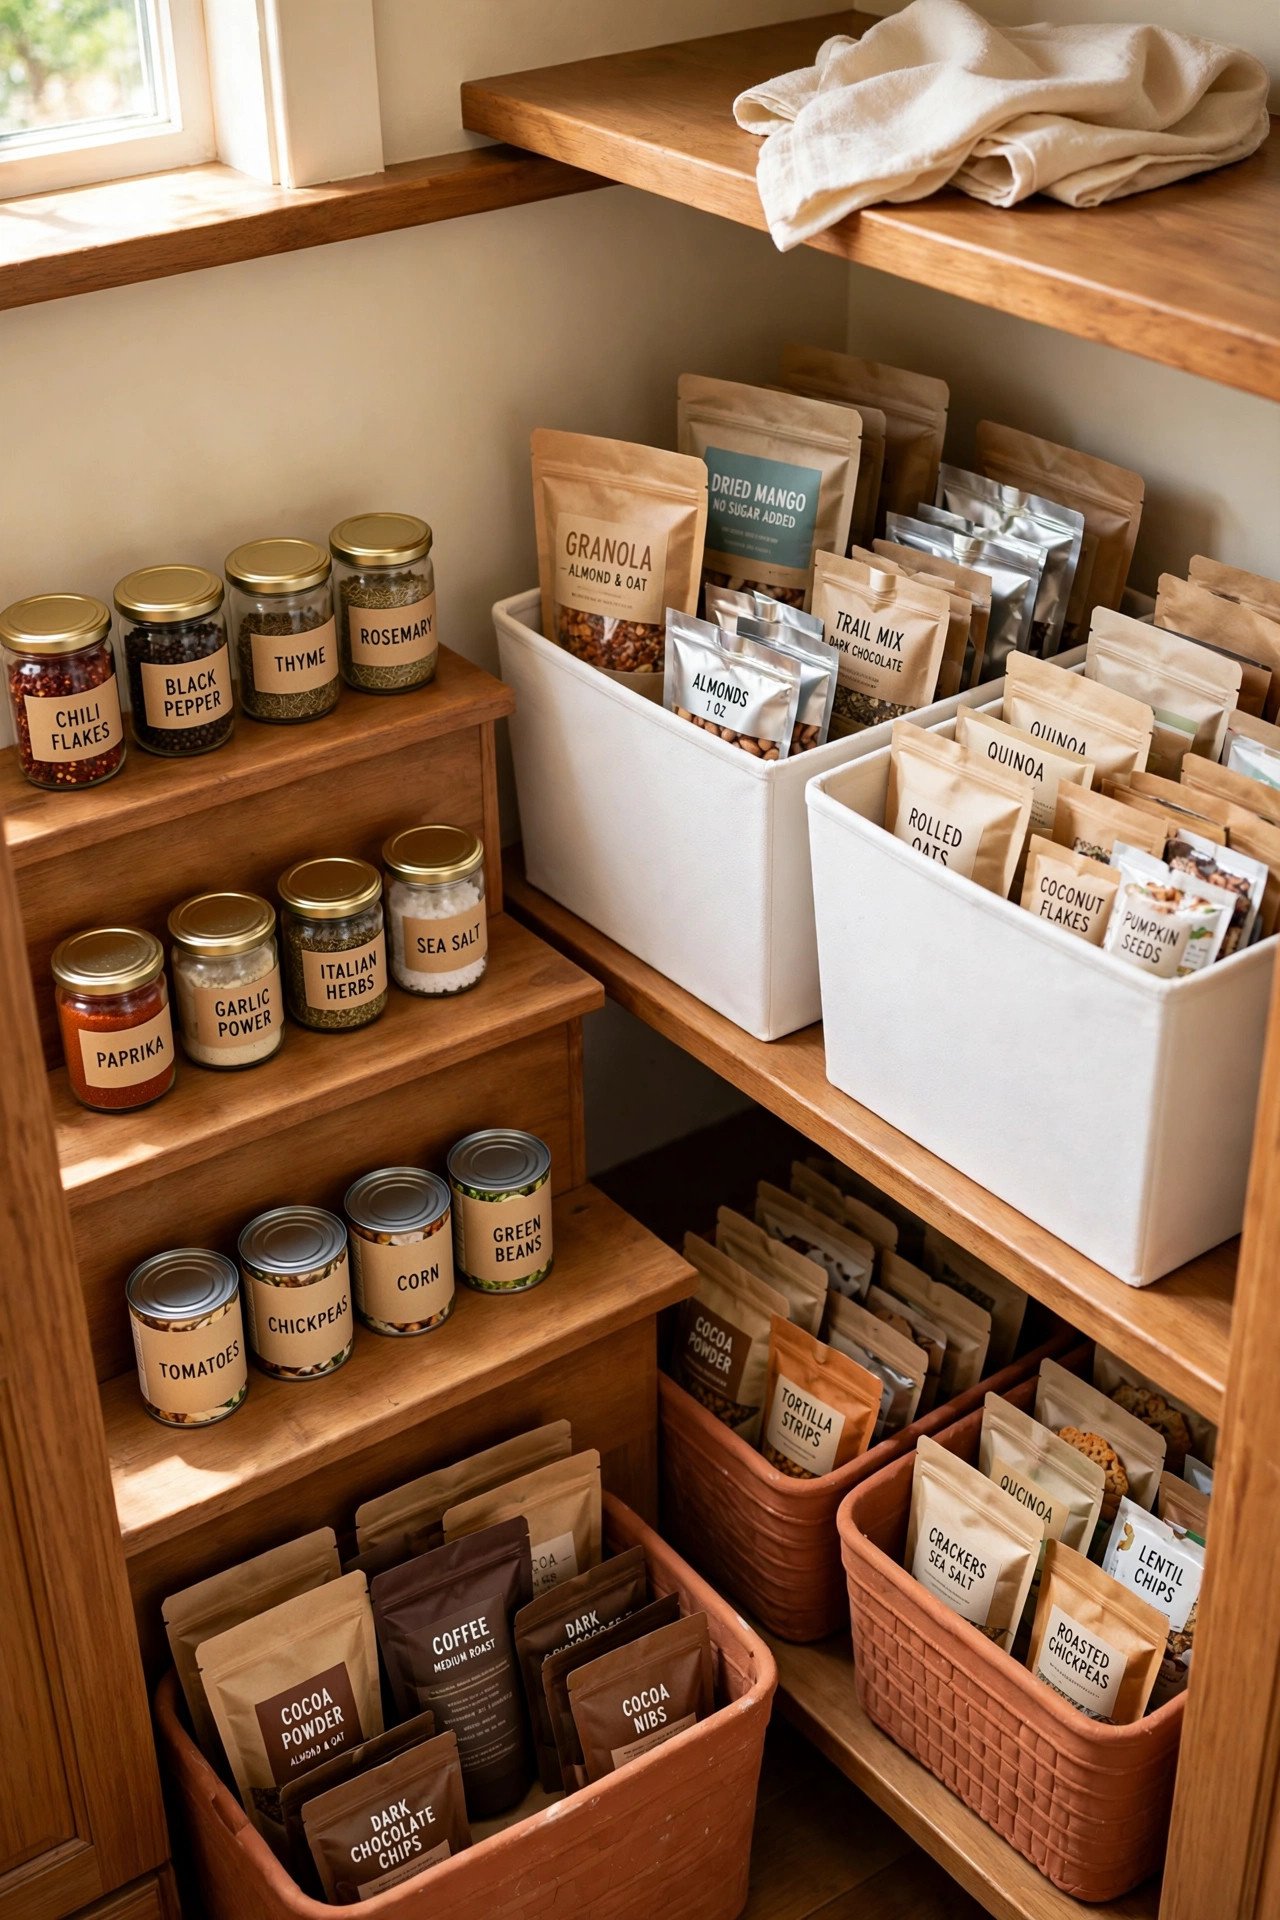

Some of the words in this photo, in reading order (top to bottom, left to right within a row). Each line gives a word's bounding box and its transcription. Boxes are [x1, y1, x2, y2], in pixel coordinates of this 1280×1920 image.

[712, 473, 752, 498] DRIED
[754, 484, 806, 512] MANGO
[713, 498, 726, 512] NO
[728, 502, 760, 520] SUGAR
[762, 510, 796, 528] ADDED
[566, 531, 652, 572] GRANOLA
[568, 564, 611, 584] ALMOND
[614, 574, 622, 586] &
[626, 576, 648, 592] OAT
[360, 614, 433, 646] ROSEMARY
[836, 611, 870, 642] TRAIL
[876, 626, 904, 652] MIX
[274, 647, 326, 673] THYME
[829, 636, 850, 654] DARK
[852, 645, 904, 672] CHOCOLATE
[166, 669, 217, 696] BLACK
[692, 673, 748, 708] ALMONDS
[56, 703, 100, 728] CHILI
[164, 691, 222, 717] PEPPER
[706, 700, 711, 712] 1
[714, 702, 726, 718] OZ
[52, 722, 110, 750] FLAKES
[988, 741, 1044, 782] QUINOA
[908, 807, 962, 848] ROLLED
[912, 837, 949, 866] OATS
[1040, 877, 1104, 914] COCONUT
[1040, 900, 1090, 933] FLAKES
[1123, 911, 1180, 946] PUMPKIN
[417, 937, 446, 954] SEA
[452, 922, 480, 951] SALT
[1121, 934, 1162, 964] SEEDS
[320, 950, 377, 980] ITALIAN
[215, 988, 270, 1018] GARLIC
[327, 975, 374, 1000] HERBS
[219, 1010, 271, 1037] POWER
[96, 1035, 164, 1068] PAPRIKA
[493, 1214, 541, 1243] GREEN
[495, 1235, 542, 1262] BEANS
[397, 1263, 440, 1291] CORN
[268, 1295, 348, 1334] CHICKPEAS
[695, 1317, 733, 1353] COCOA
[159, 1340, 240, 1380] TOMATOES
[688, 1332, 732, 1374] POWDER
[781, 1388, 832, 1434] TORTILLA
[781, 1411, 821, 1447] STRIPS
[1000, 1475, 1053, 1523] QUCINOA
[929, 1527, 987, 1579] CRACKERS
[1138, 1545, 1184, 1587] LENTIL
[928, 1550, 945, 1573] SEA
[948, 1566, 975, 1591] SALT
[1134, 1568, 1176, 1603] CHIPS
[432, 1616, 490, 1655] COFFEE
[565, 1610, 600, 1639] DARK
[434, 1651, 468, 1673] MEDIUM
[470, 1638, 496, 1658] ROAST
[1057, 1622, 1110, 1669] ROASTED
[1048, 1637, 1110, 1689] CHICKPEAS
[281, 1687, 333, 1726] COCOA
[622, 1683, 670, 1717] COCOA
[281, 1705, 344, 1750] POWDER
[633, 1706, 667, 1734] NIBS
[330, 1732, 345, 1747] OAT
[370, 1798, 411, 1832] DARK
[350, 1806, 436, 1863] CHOCOLATE
[379, 1835, 422, 1869] CHIPS
